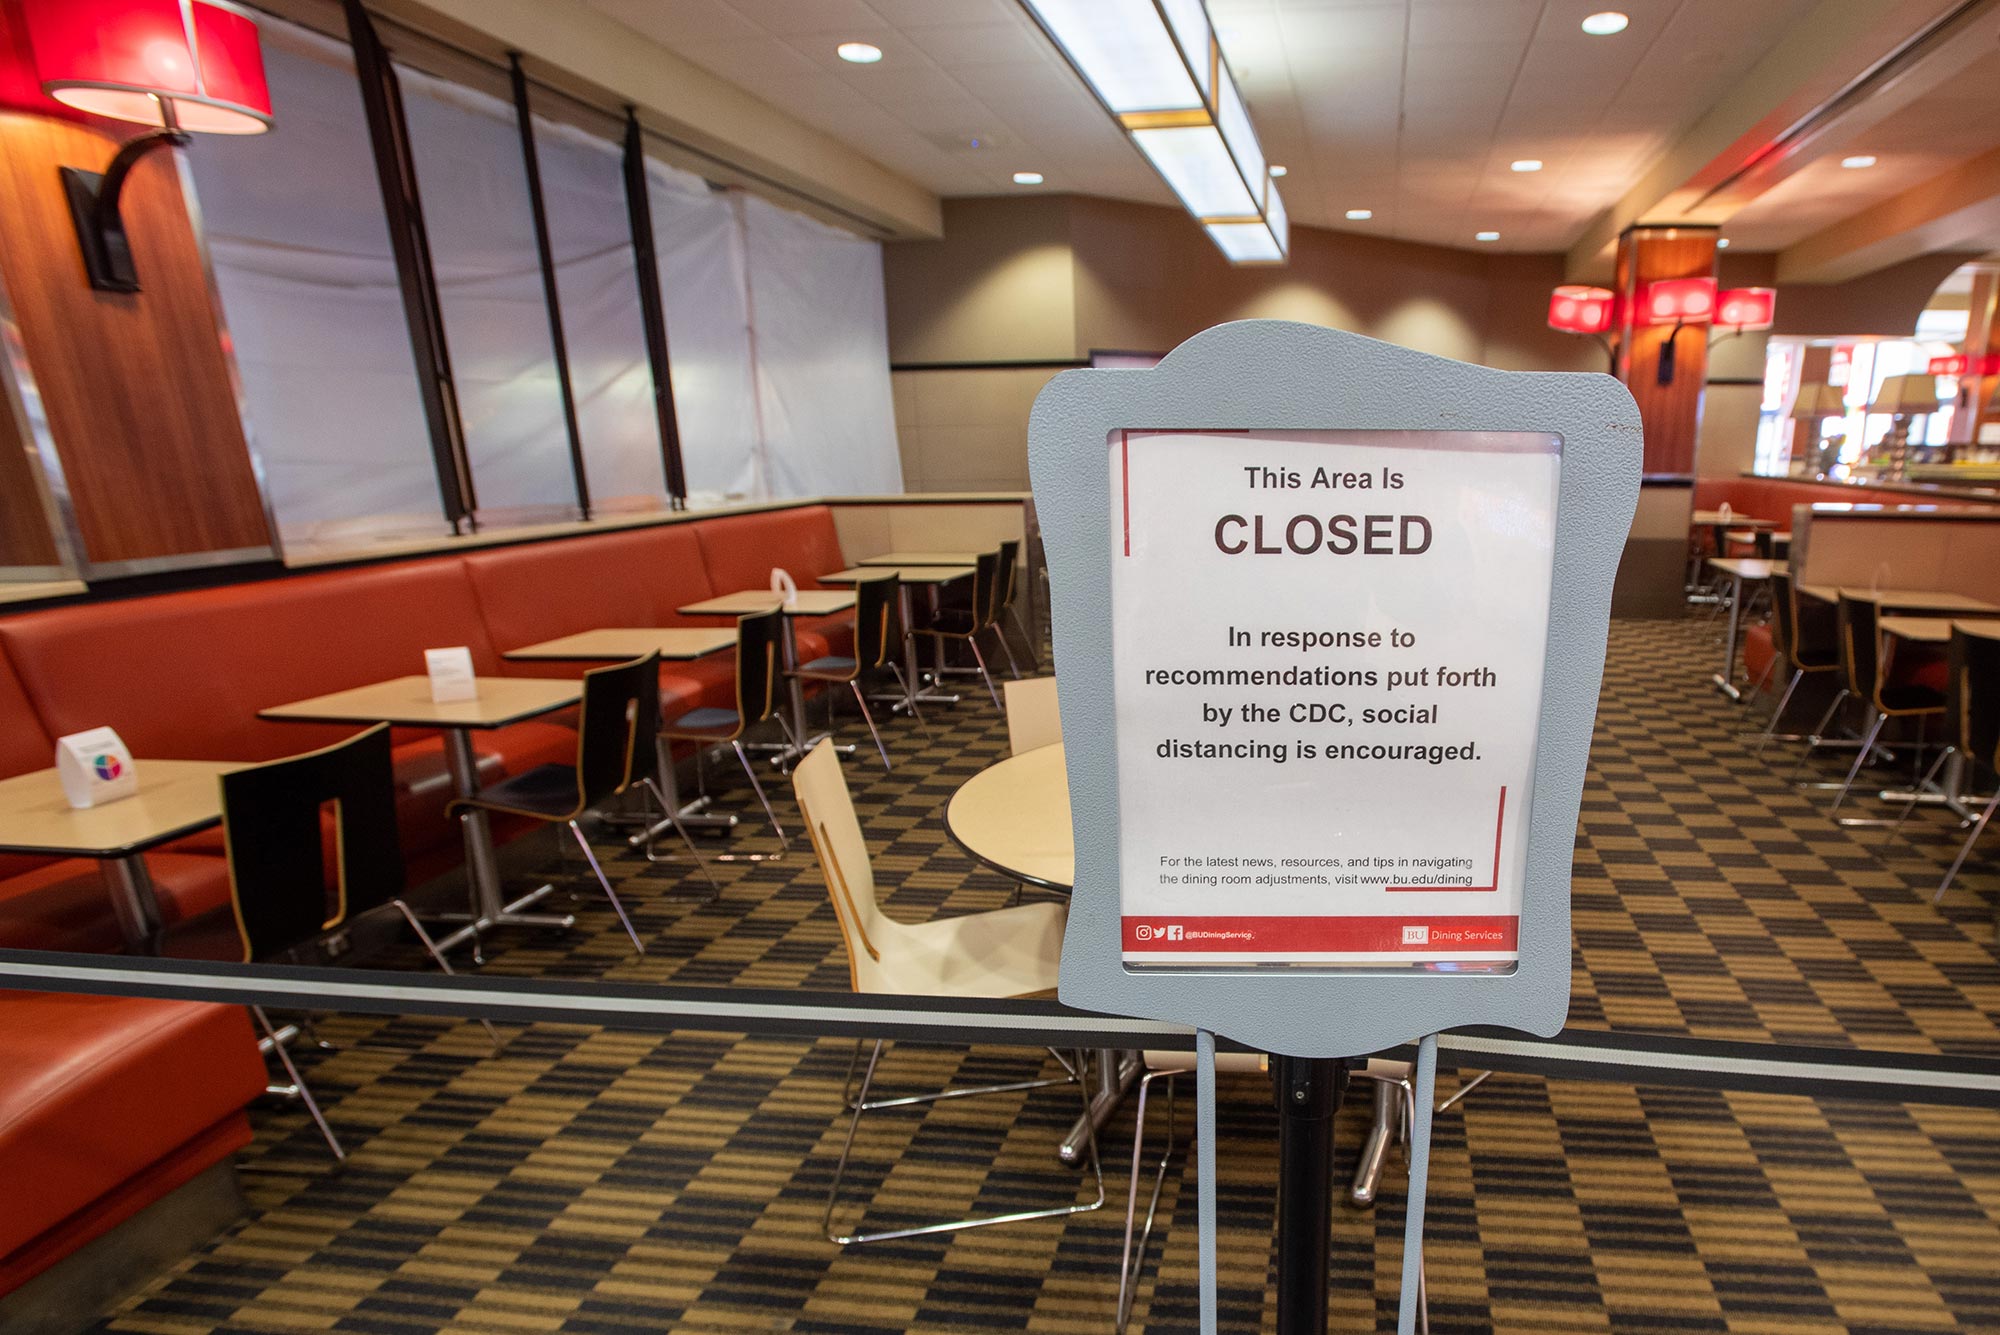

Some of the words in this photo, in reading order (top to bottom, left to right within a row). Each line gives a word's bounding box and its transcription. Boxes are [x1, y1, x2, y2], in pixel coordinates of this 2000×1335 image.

[1243, 466, 1302, 490] This
[1310, 466, 1373, 490] Area
[1382, 466, 1405, 490] Is
[1214, 513, 1433, 556] CLOSED
[1228, 625, 1252, 647] In
[1260, 631, 1382, 653] response
[1390, 627, 1416, 648] to
[1145, 665, 1378, 687] recommendations
[1386, 667, 1430, 692] put
[1436, 666, 1497, 688] forth
[1203, 702, 1234, 728] by
[1240, 702, 1281, 723] the
[1289, 702, 1353, 727] CDC,
[1361, 703, 1438, 724] social
[1156, 738, 1288, 764] distancing
[1296, 739, 1317, 760] is
[1324, 741, 1481, 765] encouraged.
[1160, 855, 1181, 867] For
[1183, 856, 1203, 867] the
[1206, 856, 1239, 867] latest
[1242, 858, 1277, 868] news,
[1280, 858, 1343, 869] resources,
[1347, 856, 1370, 868] and
[1373, 856, 1395, 870] tips
[1397, 856, 1409, 867] in
[1412, 856, 1473, 870] navigating
[1159, 873, 1179, 885] the
[1181, 873, 1218, 887] dining
[1221, 875, 1252, 885] room
[1255, 873, 1331, 887] adjustments,
[1334, 873, 1358, 885] visit
[1359, 873, 1473, 888] www.bu.edu/dining
[1407, 930, 1425, 940] BU
[1431, 930, 1462, 941] Dining
[1464, 930, 1504, 940] Services
